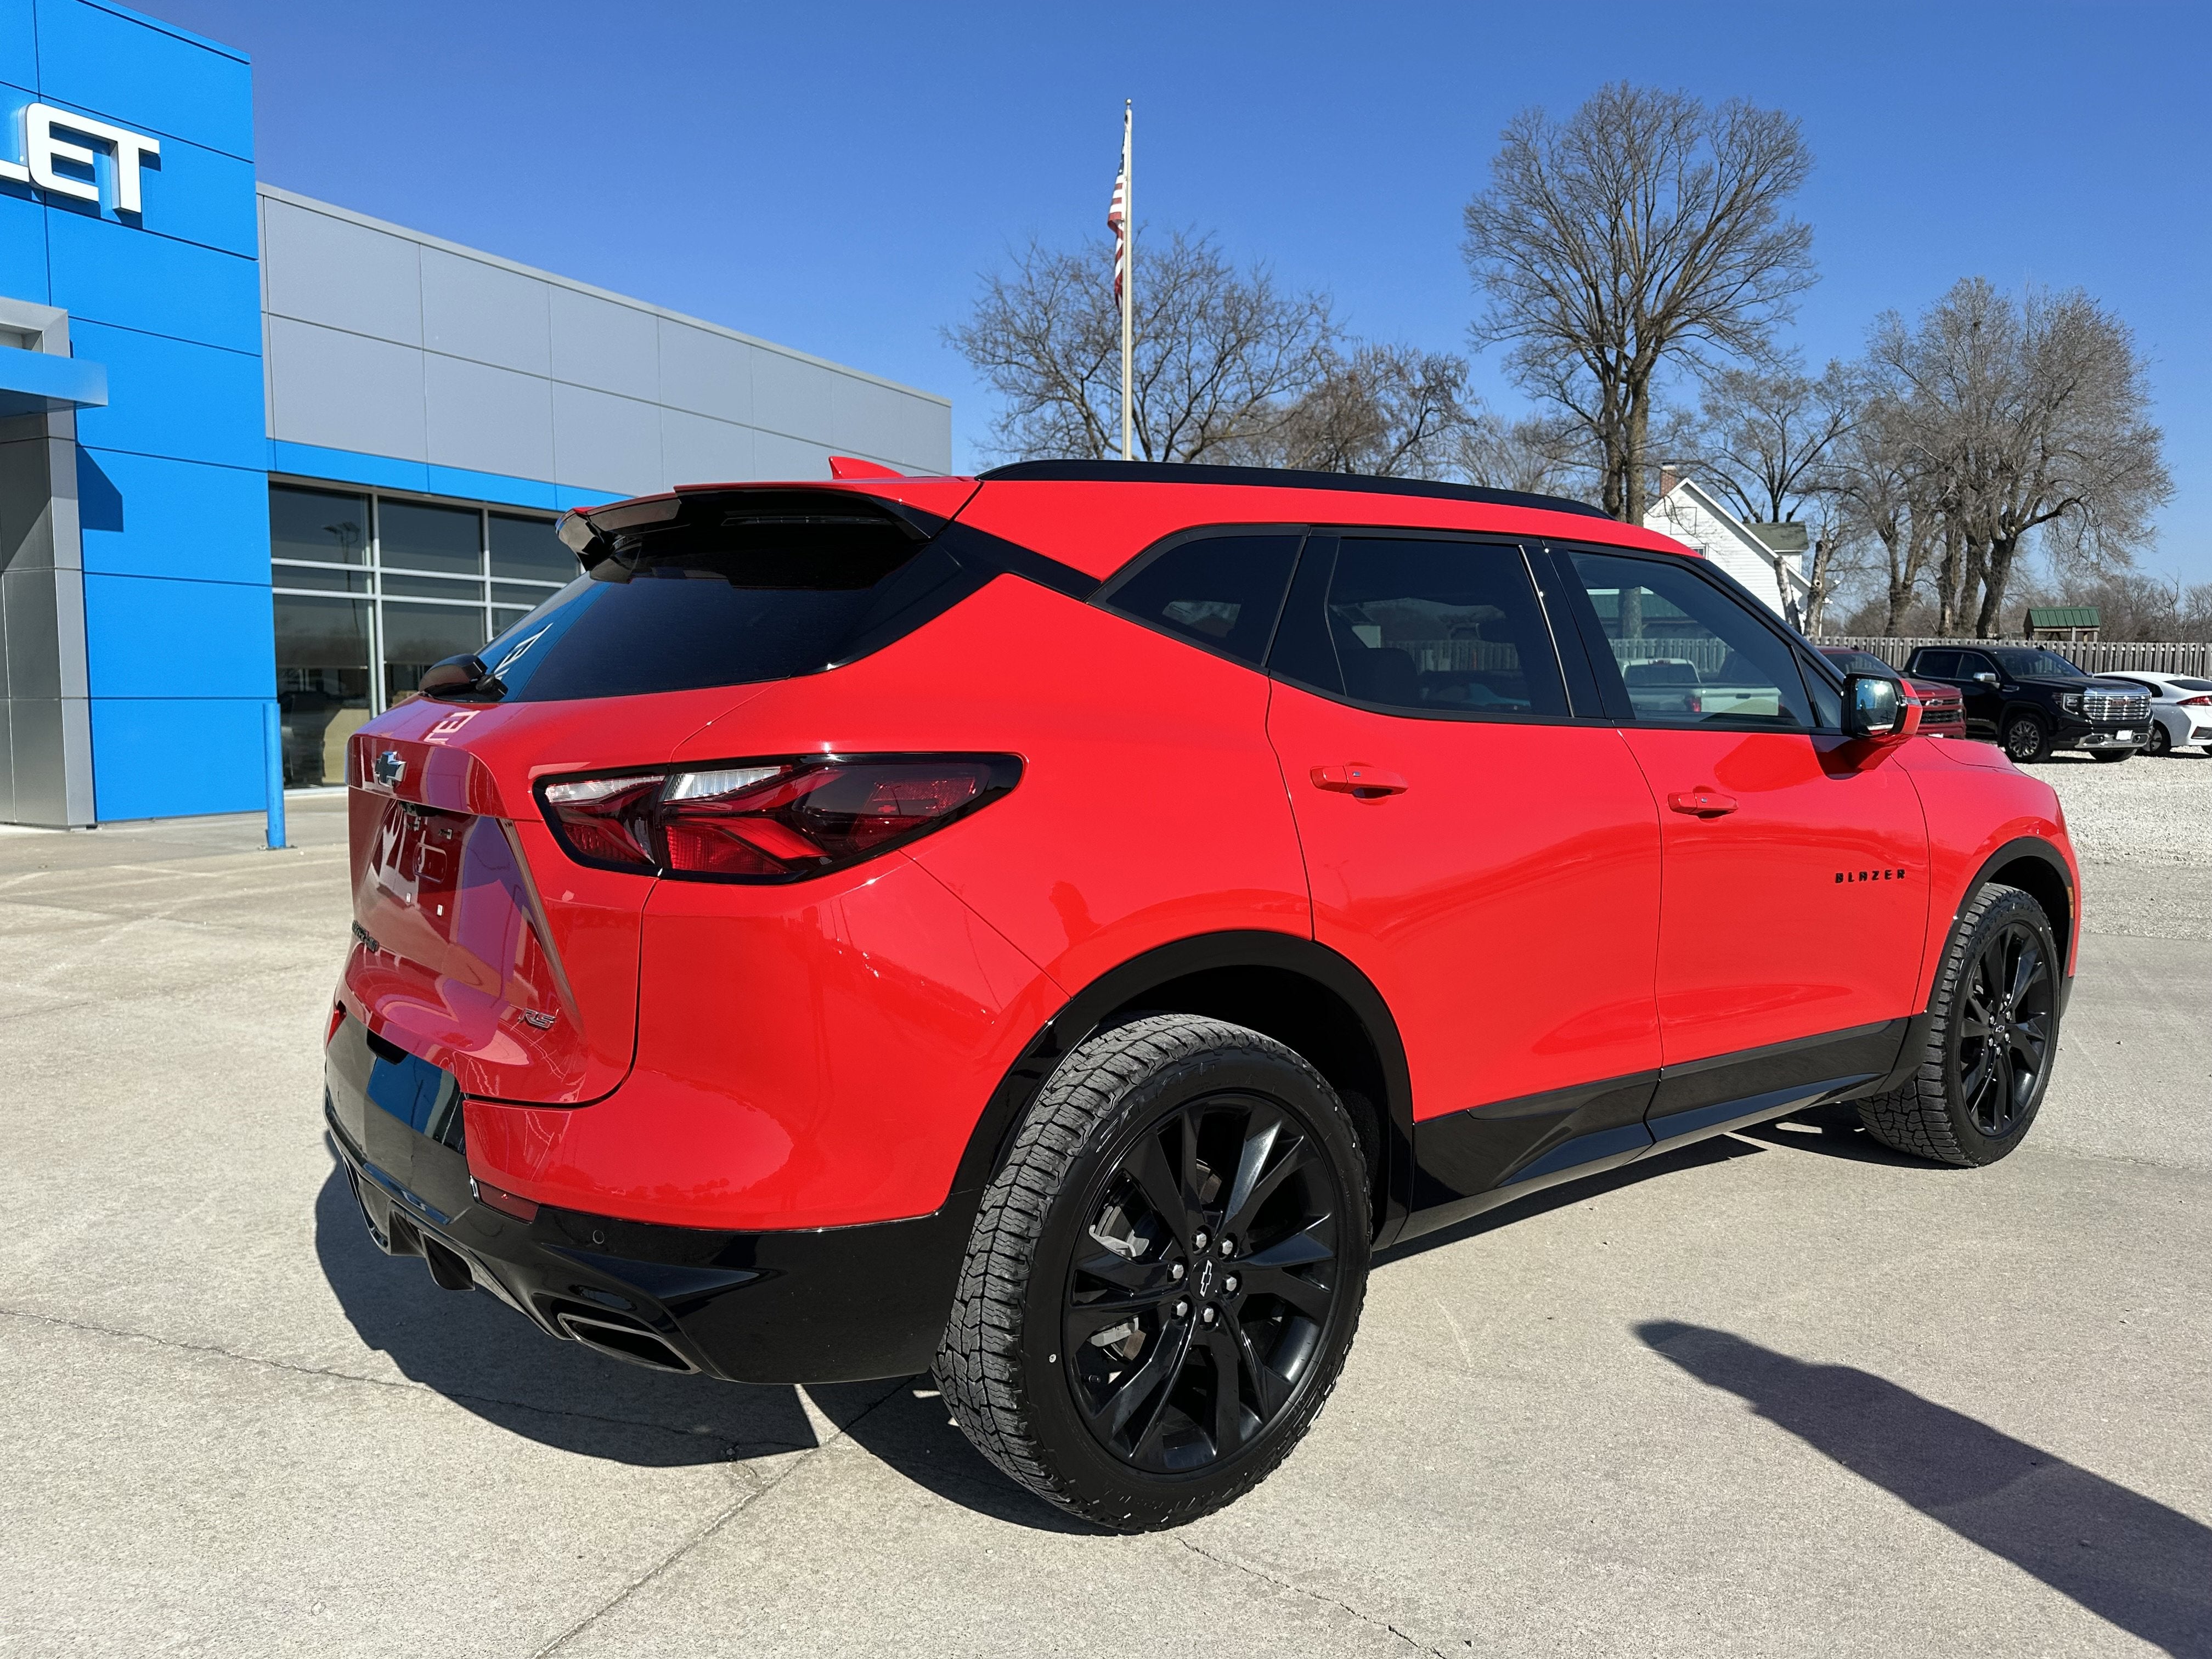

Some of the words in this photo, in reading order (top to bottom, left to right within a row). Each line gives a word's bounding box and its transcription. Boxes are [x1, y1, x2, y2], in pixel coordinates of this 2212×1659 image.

[0, 102, 160, 213] ET
[1835, 868, 1906, 884] BLAZER
[518, 1007, 556, 1029] RS
